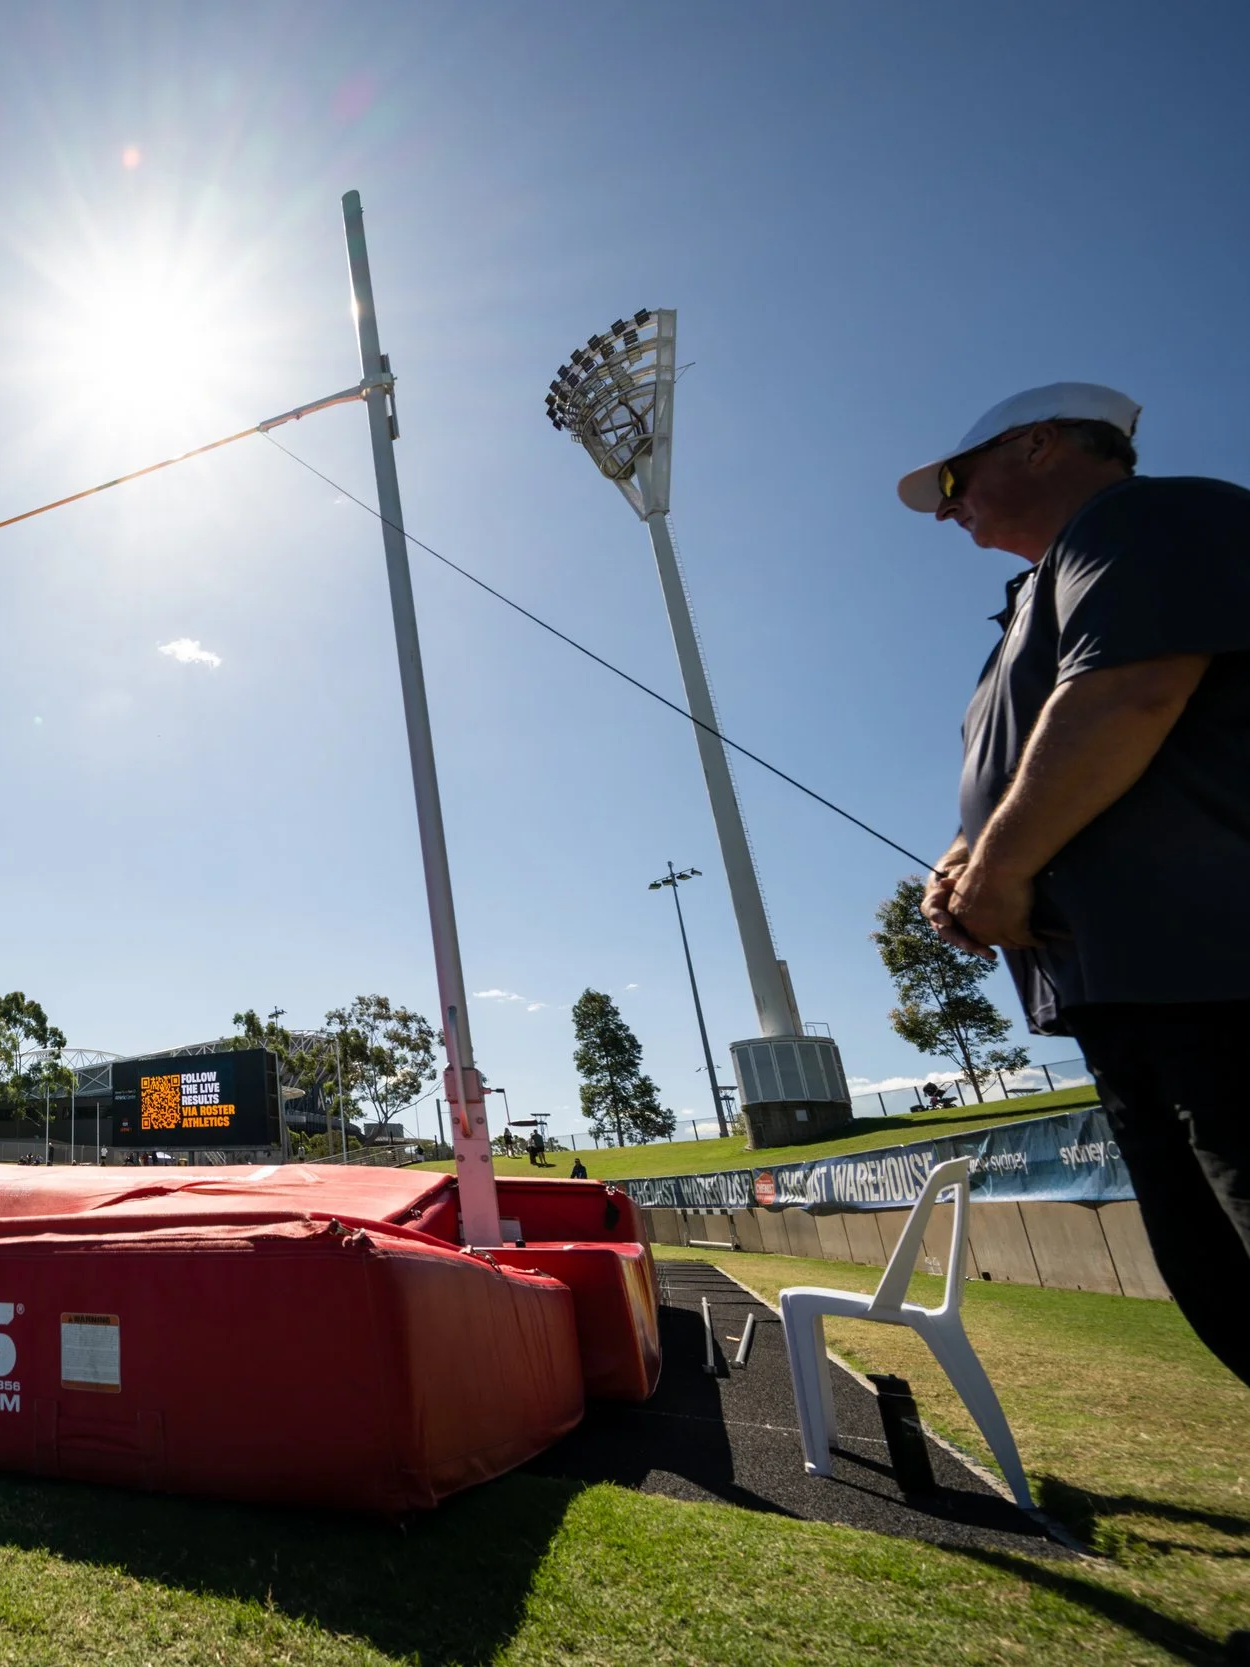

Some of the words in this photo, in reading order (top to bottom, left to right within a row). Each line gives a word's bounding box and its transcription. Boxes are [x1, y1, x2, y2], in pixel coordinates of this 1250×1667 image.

[181, 1071, 217, 1084] FOLLOW
[181, 1084, 198, 1095] THE
[200, 1082, 220, 1094] LIVE
[181, 1094, 220, 1106] RESULTS
[182, 1105, 198, 1117] VIA
[200, 1104, 235, 1116] ROSTER
[182, 1116, 230, 1128] ATHLETICS
[991, 1149, 1029, 1176] sydney
[628, 1178, 677, 1207] CHEMIST
[678, 1173, 749, 1206] WAREHOUSE
[778, 1166, 828, 1204] CHEMIST
